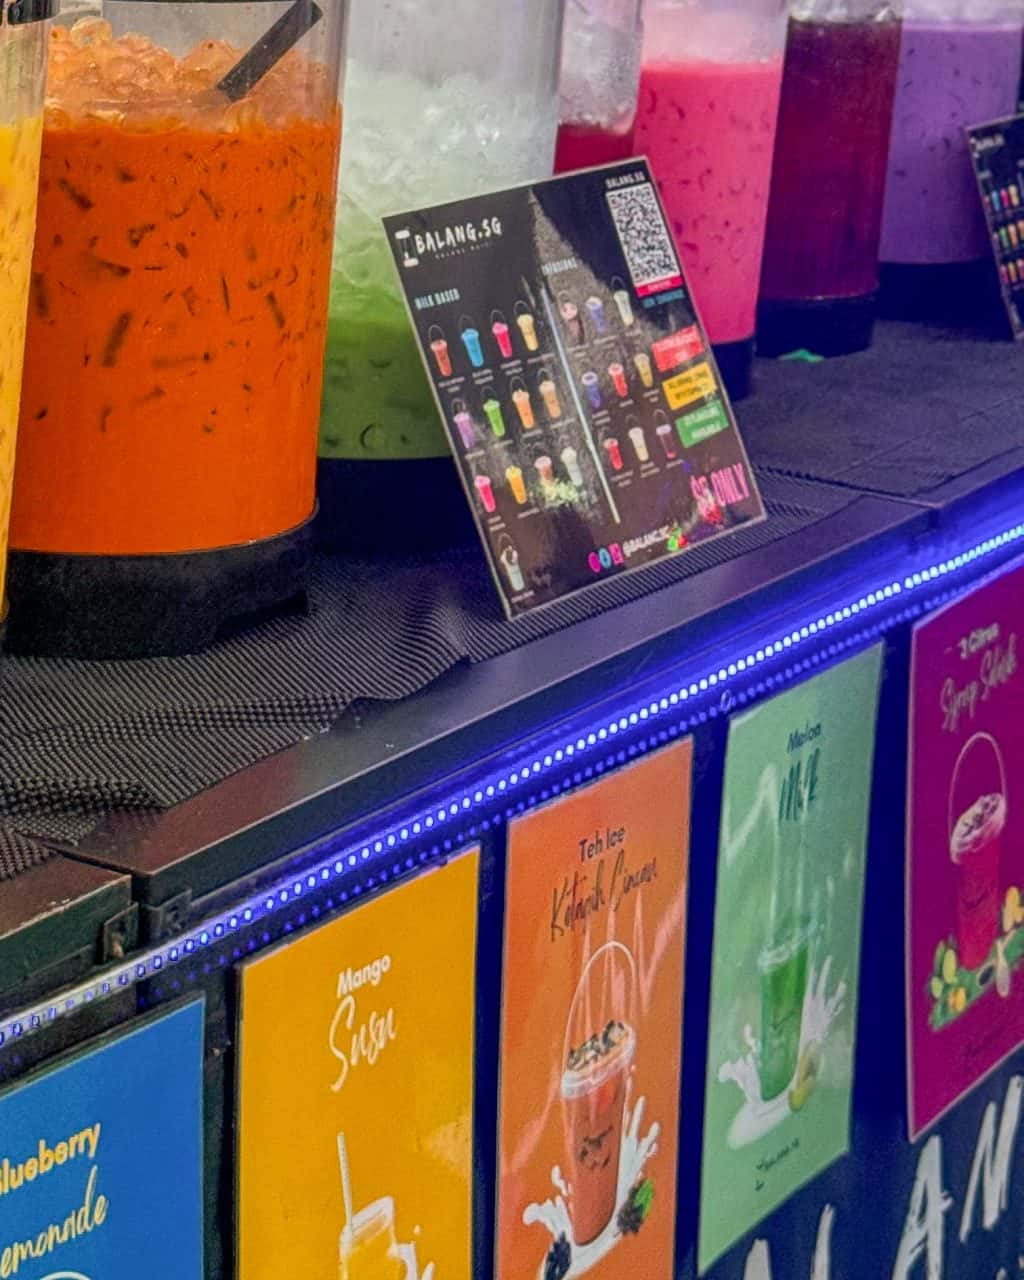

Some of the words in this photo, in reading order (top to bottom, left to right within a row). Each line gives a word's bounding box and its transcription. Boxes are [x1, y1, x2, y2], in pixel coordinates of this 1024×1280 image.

[414, 217, 503, 254] BALANG.SG
[711, 462, 750, 507] ONLY
[579, 829, 603, 862] Teh
[606, 826, 625, 849] Ice
[337, 955, 391, 998] Mango
[329, 994, 397, 1092] Susu
